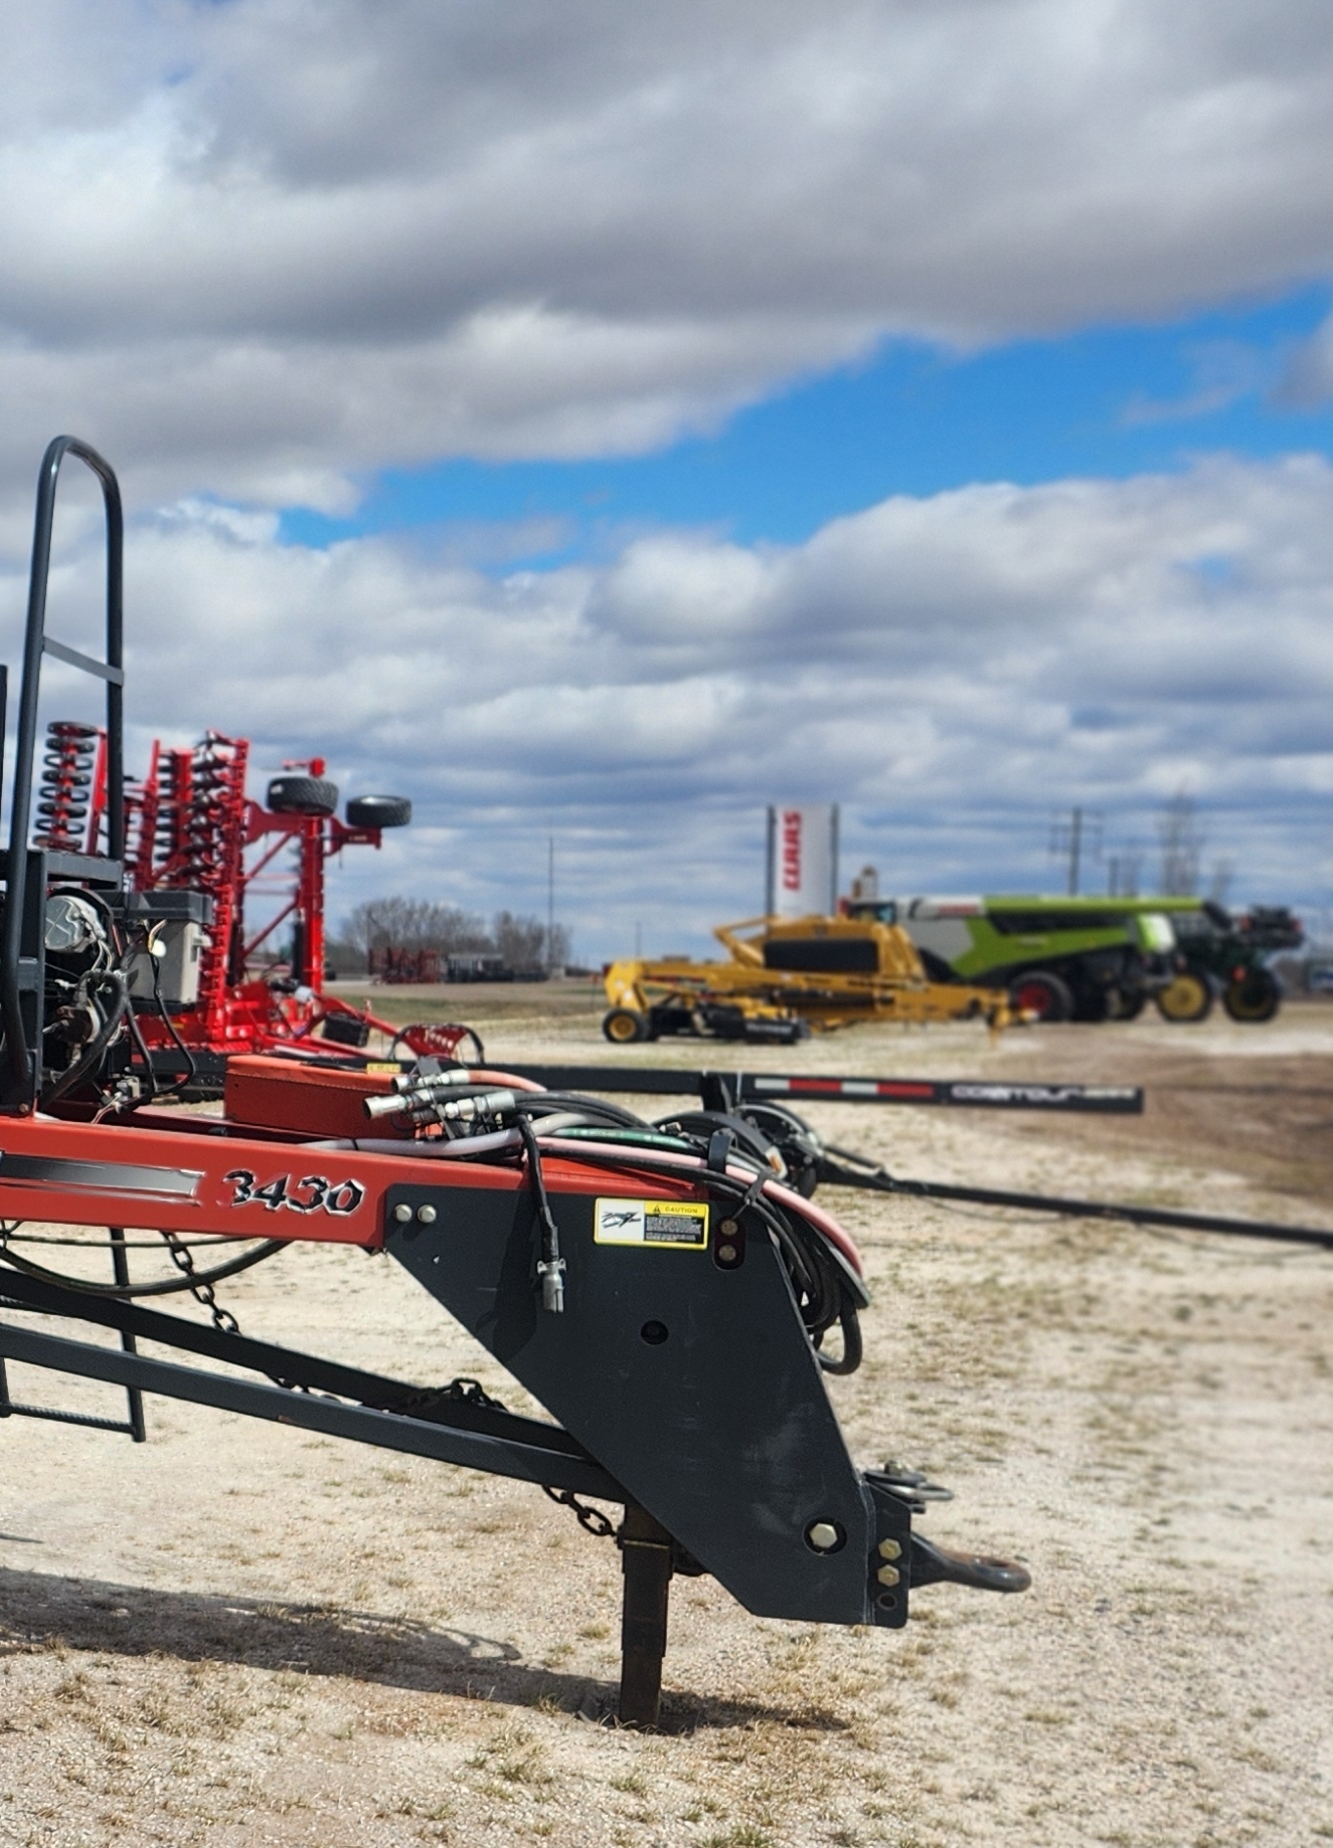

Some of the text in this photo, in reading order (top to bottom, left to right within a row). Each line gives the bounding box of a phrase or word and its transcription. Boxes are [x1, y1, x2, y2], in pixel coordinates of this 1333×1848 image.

[783, 811, 801, 891] CLAAS
[222, 1169, 365, 1215] 3430
[664, 1206, 698, 1214] CAUTION
